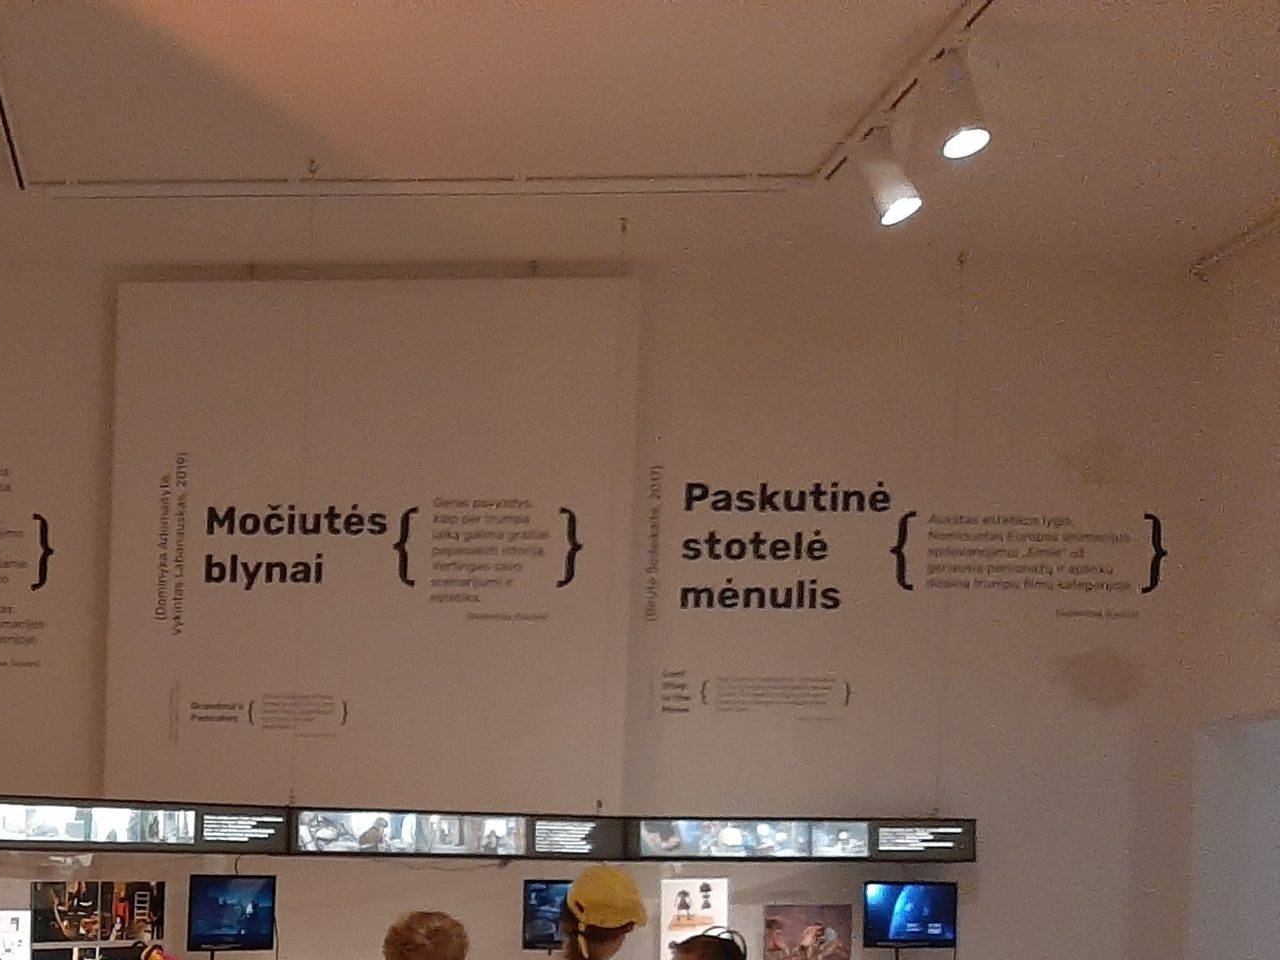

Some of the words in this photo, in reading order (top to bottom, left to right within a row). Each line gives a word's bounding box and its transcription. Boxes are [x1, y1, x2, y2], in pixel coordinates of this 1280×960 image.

[683, 480, 892, 514] Paskutinė
[206, 503, 388, 537] Močiutės
[681, 529, 829, 562] stotelė
[204, 553, 323, 591] blynai
[679, 576, 842, 610] mėnulis
